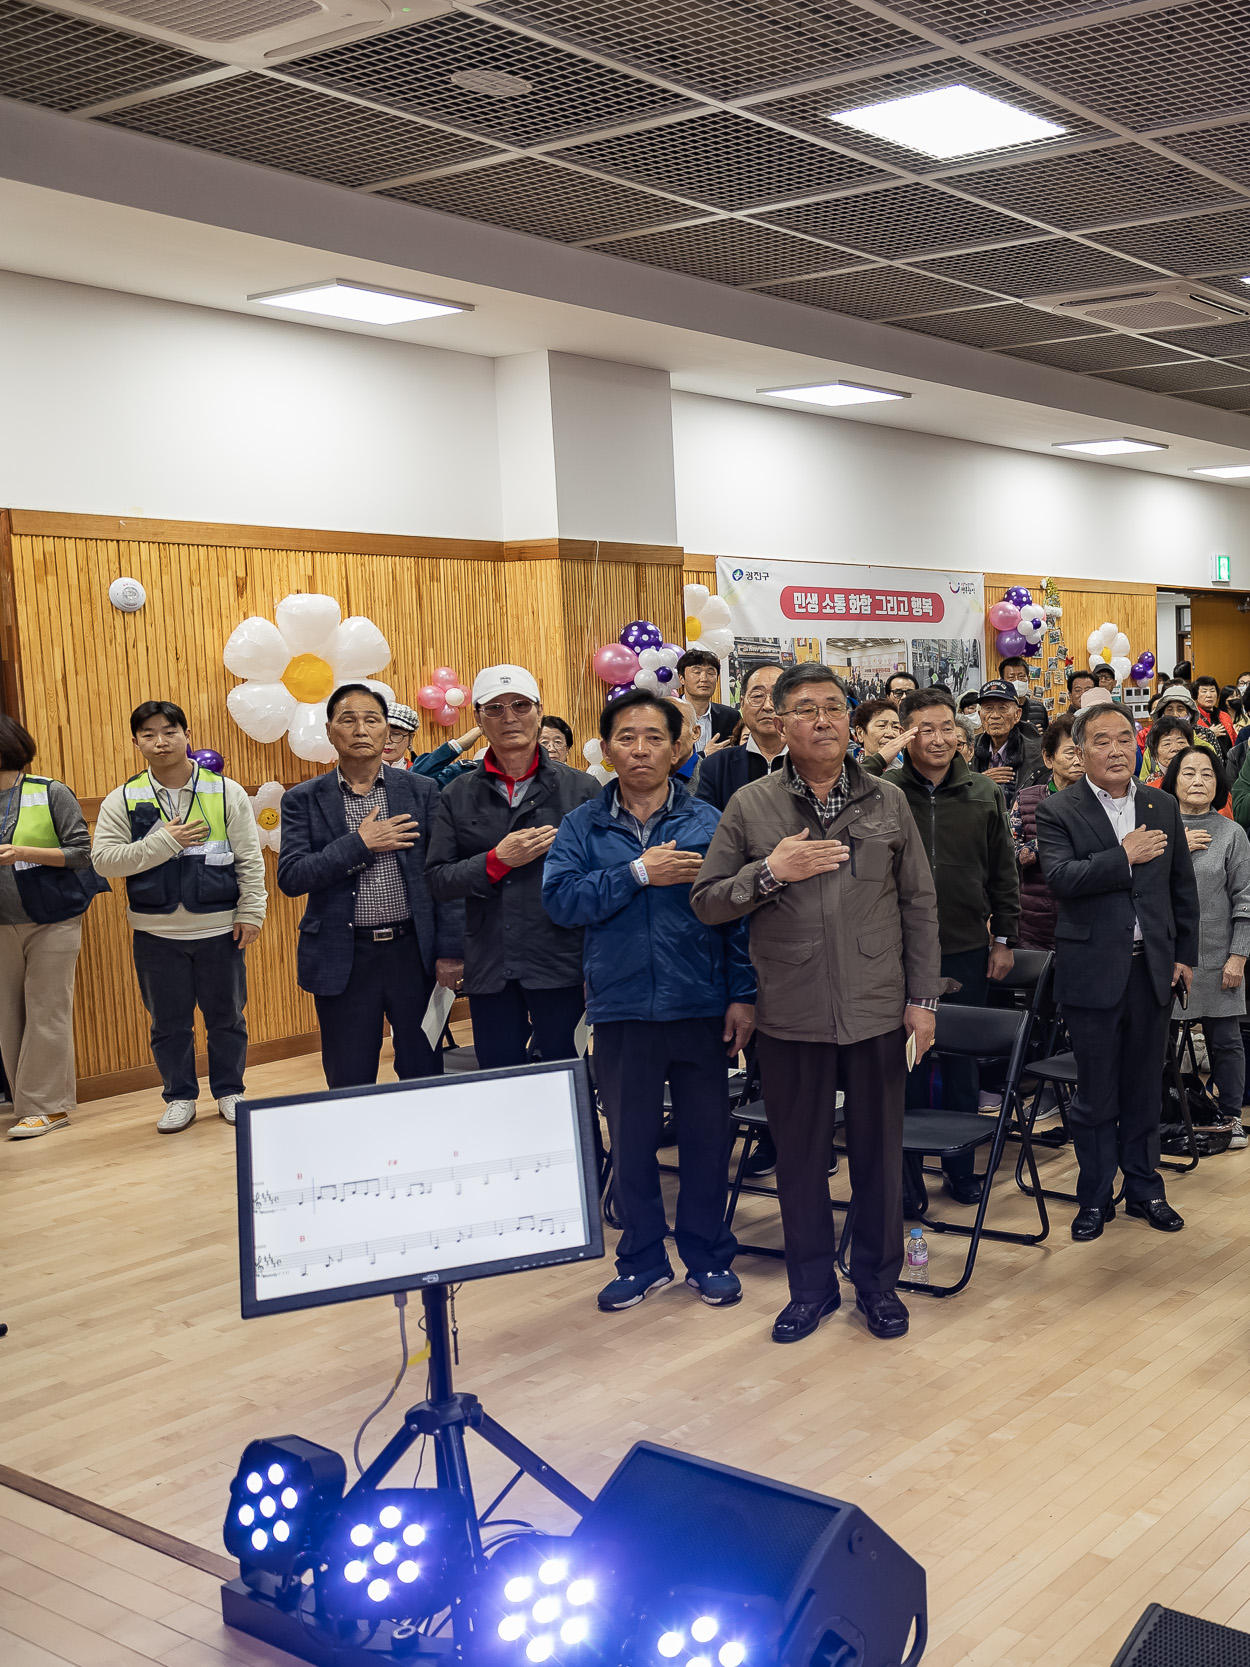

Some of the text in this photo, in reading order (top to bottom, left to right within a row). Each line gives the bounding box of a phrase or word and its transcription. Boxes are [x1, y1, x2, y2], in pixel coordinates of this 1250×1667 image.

[745, 571, 770, 580] 광진구
[793, 592, 933, 617] 민생 소통 화합 그리고 행복
